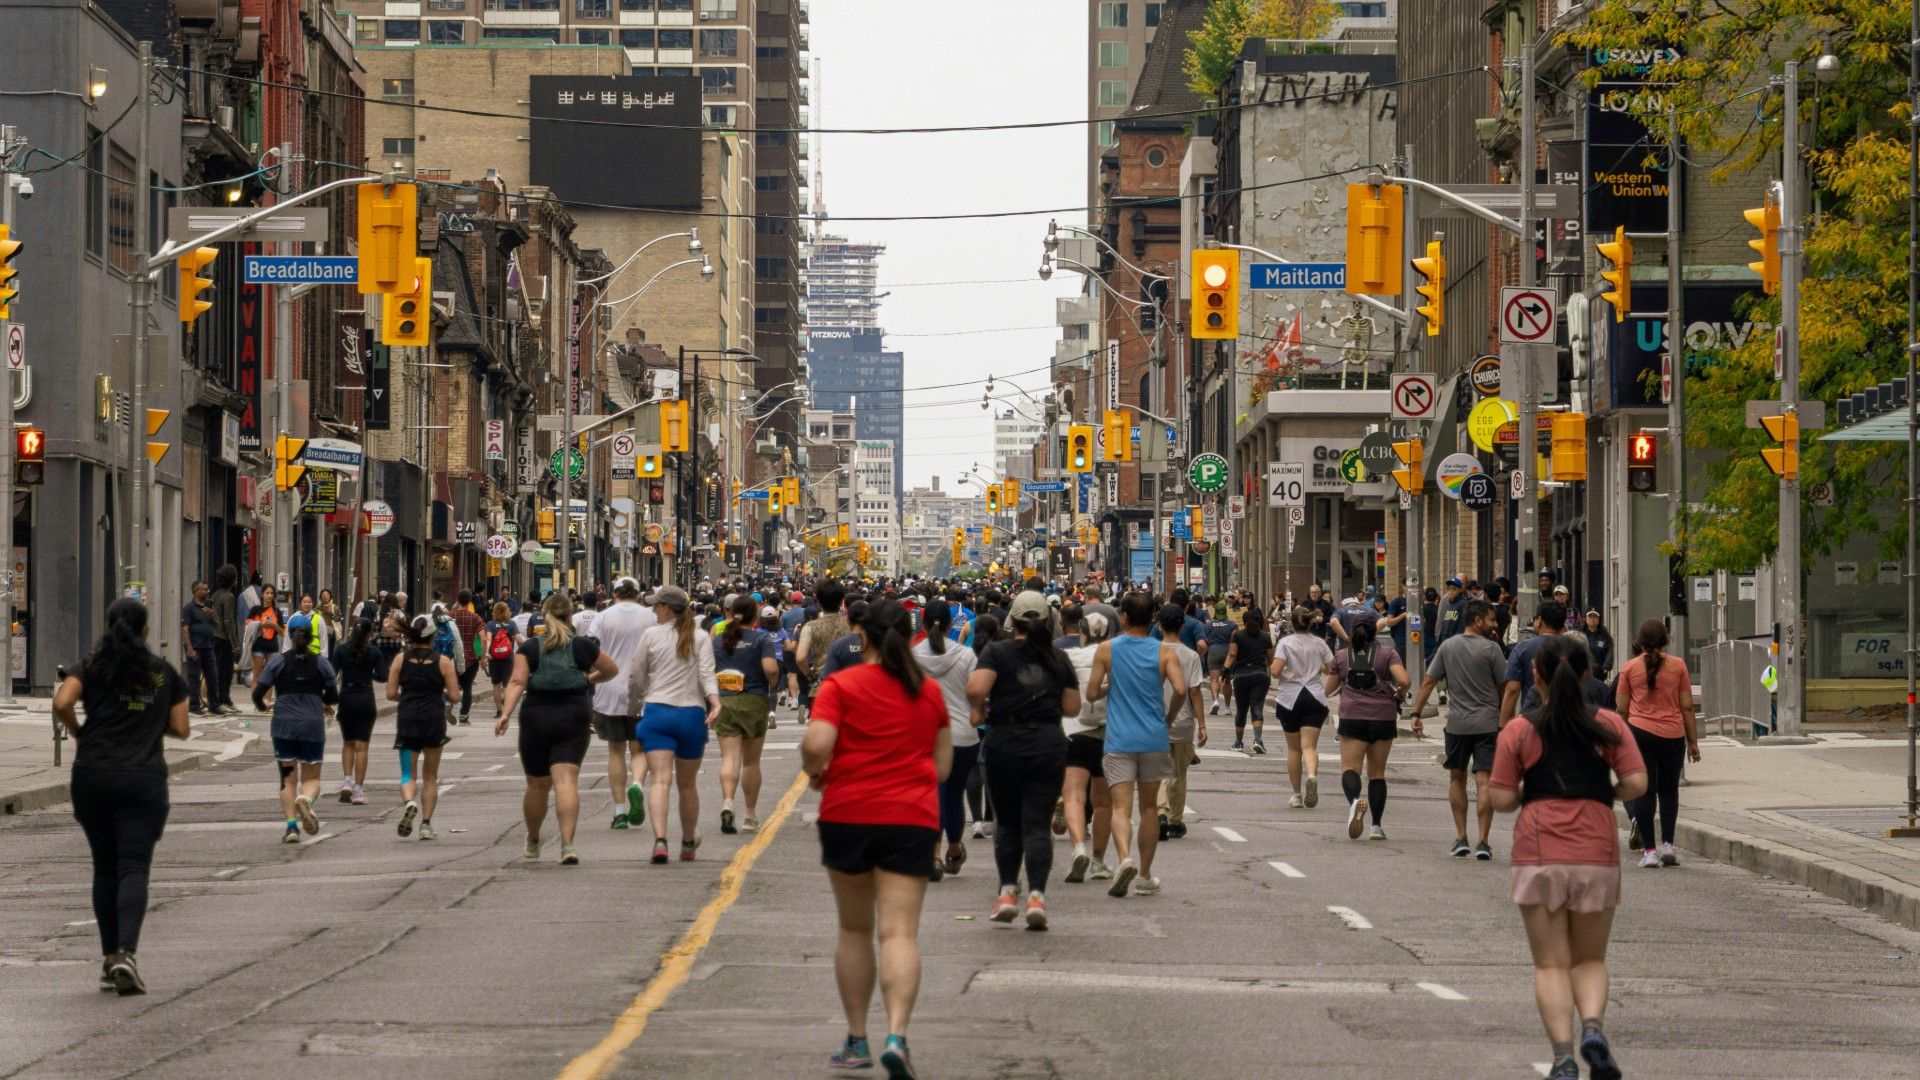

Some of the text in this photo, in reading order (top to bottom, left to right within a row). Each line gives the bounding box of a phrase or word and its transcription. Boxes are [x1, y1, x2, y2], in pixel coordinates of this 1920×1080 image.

[1595, 172, 1652, 184] Western
[1613, 184, 1652, 197] Union
[249, 261, 354, 279] Breadalbane
[1265, 268, 1345, 285] Maitland
[1476, 416, 1493, 425] EGG
[487, 421, 501, 453] SPA
[1392, 425, 1430, 439] LCO
[1476, 427, 1497, 437] CLU
[239, 436, 260, 446] hisha
[306, 449, 360, 464] Breadalbane St
[1271, 467, 1302, 475] MAXIMUM
[1272, 481, 1301, 500] 40
[487, 540, 507, 550] SPA
[1854, 639, 1891, 654] FOR
[1878, 659, 1905, 672] sq.ft
